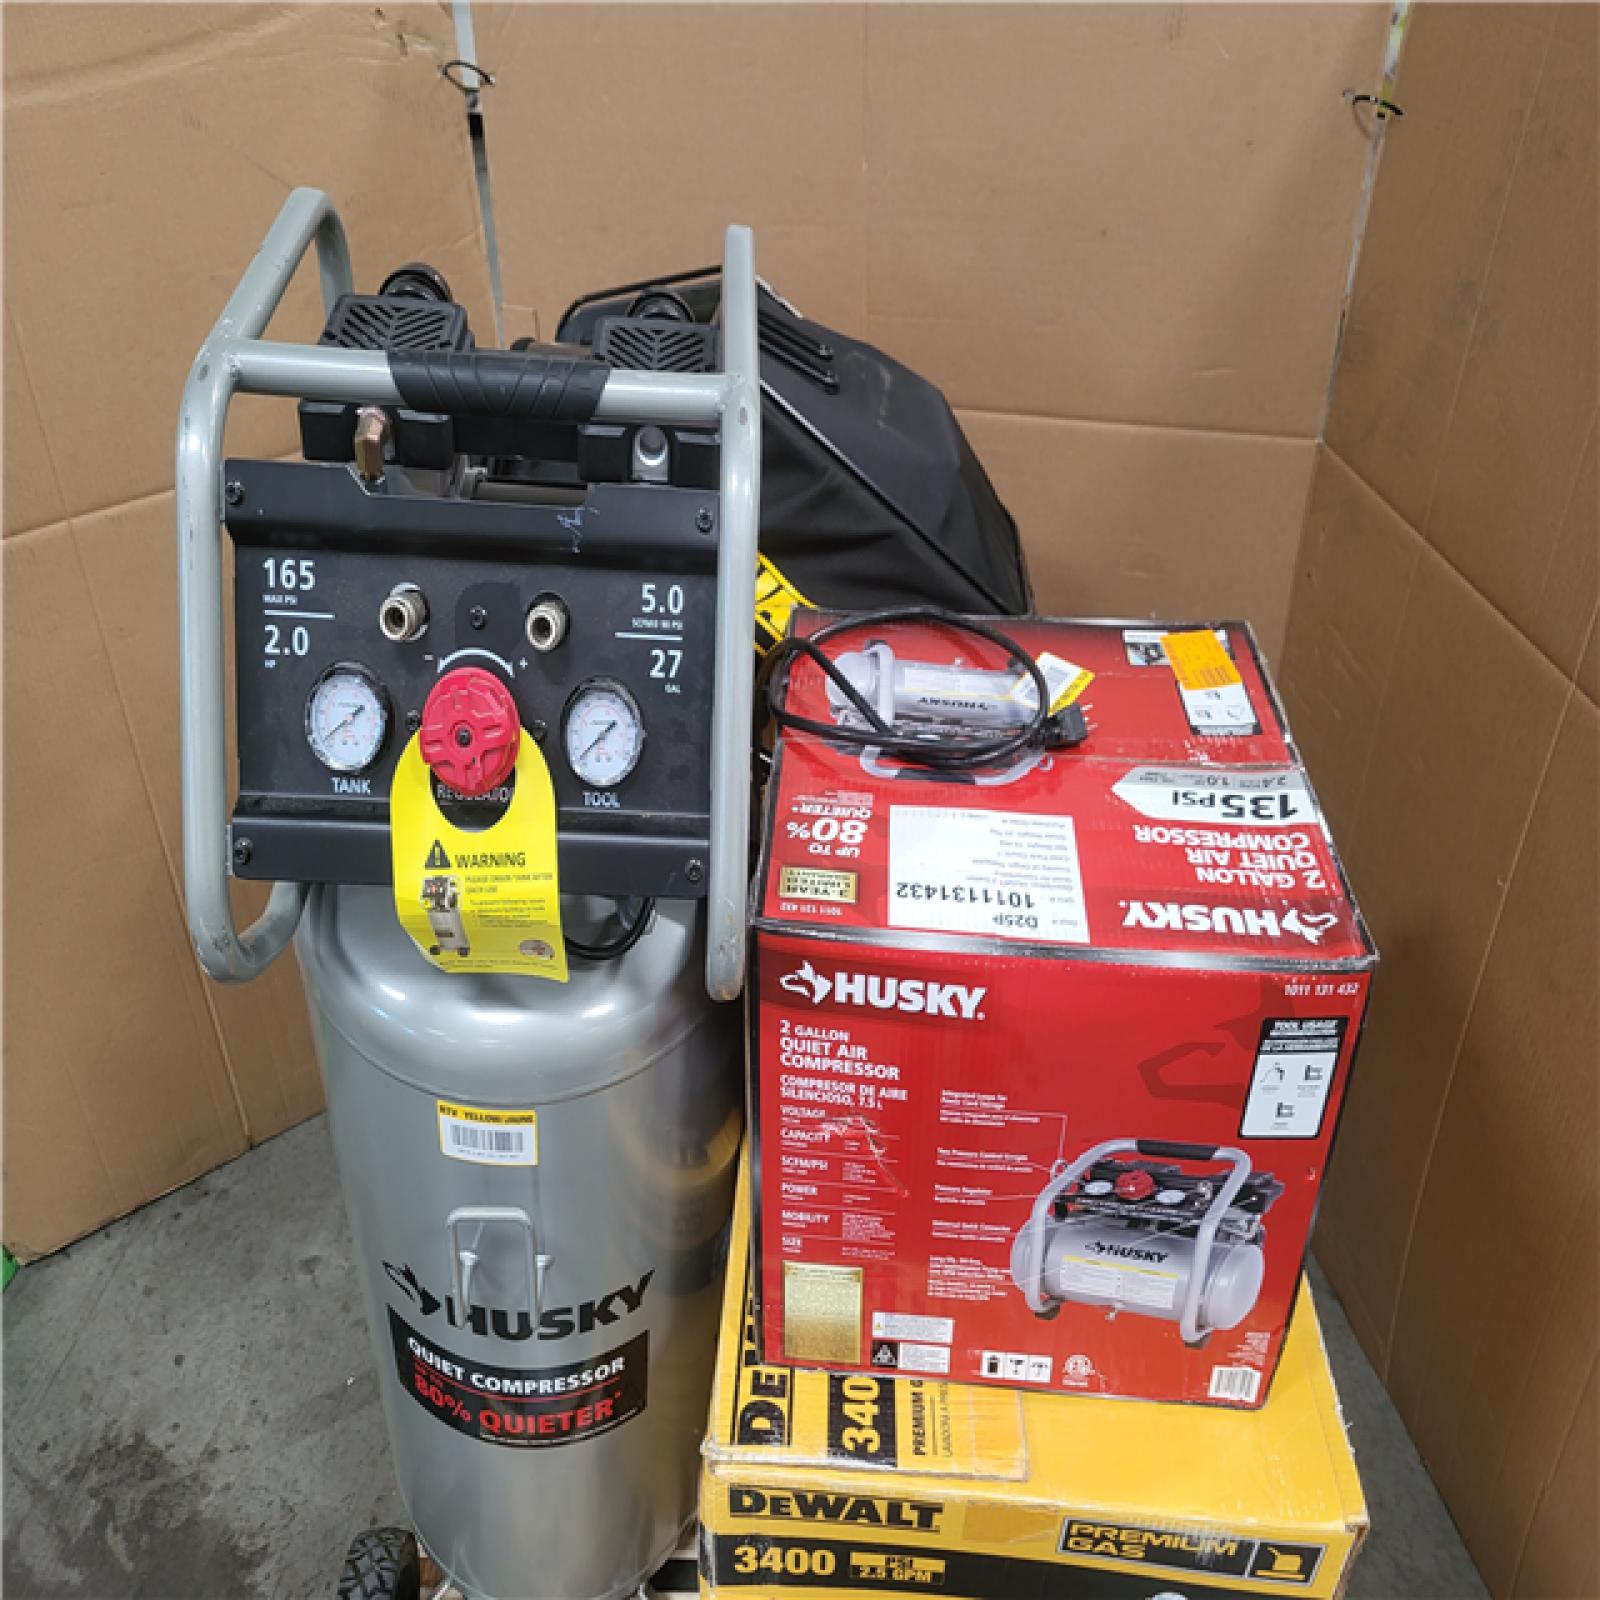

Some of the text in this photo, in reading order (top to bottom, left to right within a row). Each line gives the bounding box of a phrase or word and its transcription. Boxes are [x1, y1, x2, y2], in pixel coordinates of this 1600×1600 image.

[263, 558, 316, 590] 165
[641, 583, 684, 615] 5.0
[264, 624, 309, 656] 2.0
[649, 648, 684, 679] 27
[331, 777, 371, 795] TANK
[583, 791, 621, 808] TOOL
[786, 818, 868, 844] 80%
[1133, 825, 1310, 851] COMPRESSOR
[454, 852, 527, 869] WARNING
[809, 843, 861, 858] UP TO
[1184, 847, 1318, 869] QUIET AIR
[1195, 866, 1326, 889] 2 GALLON
[895, 882, 1036, 910] 1011131432
[780, 1019, 849, 1042] 2 GALLON
[780, 1036, 868, 1060] QUIET AIR
[780, 1053, 901, 1080] COMPRESSOR
[780, 1074, 908, 1101] COMPRESOR DE AIRE
[780, 1104, 826, 1119] VOLTAGE
[780, 1127, 831, 1144] CAPACITY
[781, 1181, 818, 1195] POWER
[781, 1208, 830, 1224] MOBILITY
[445, 1268, 655, 1341] HUSKY
[408, 1336, 466, 1381] QUIET
[469, 1356, 626, 1396] COMPRESSOR
[842, 1377, 880, 1454] 340
[909, 1391, 927, 1457] PREMIUM
[730, 1488, 944, 1530] DEWALT
[1066, 1537, 1146, 1558] GAS
[1070, 1523, 1239, 1556] PREMIUM
[734, 1545, 836, 1576] 3400
